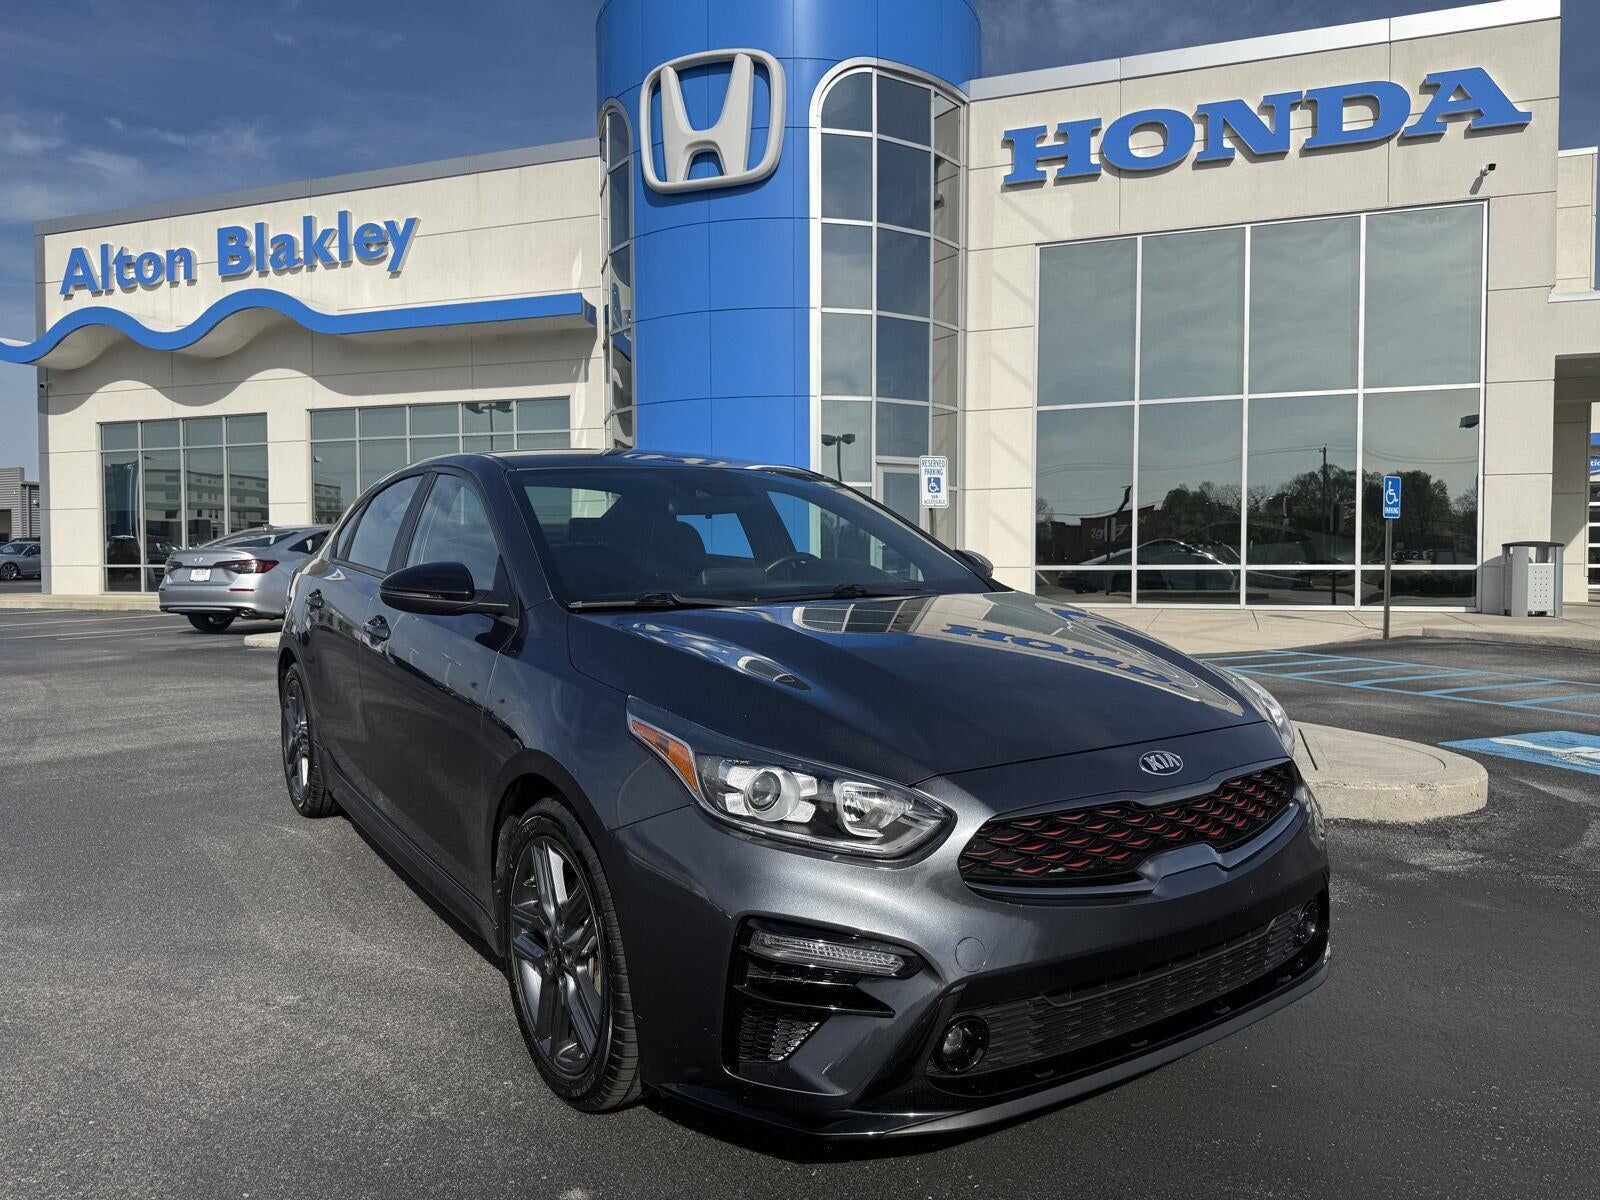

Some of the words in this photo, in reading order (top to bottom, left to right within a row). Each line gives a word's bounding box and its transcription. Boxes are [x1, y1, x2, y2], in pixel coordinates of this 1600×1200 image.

[1001, 66, 1532, 188] HONDA
[60, 243, 196, 298] Alton
[216, 210, 420, 276] Blakley
[921, 459, 945, 468] RESERVED
[924, 468, 943, 476] PARKING
[1143, 753, 1180, 771] KIA
